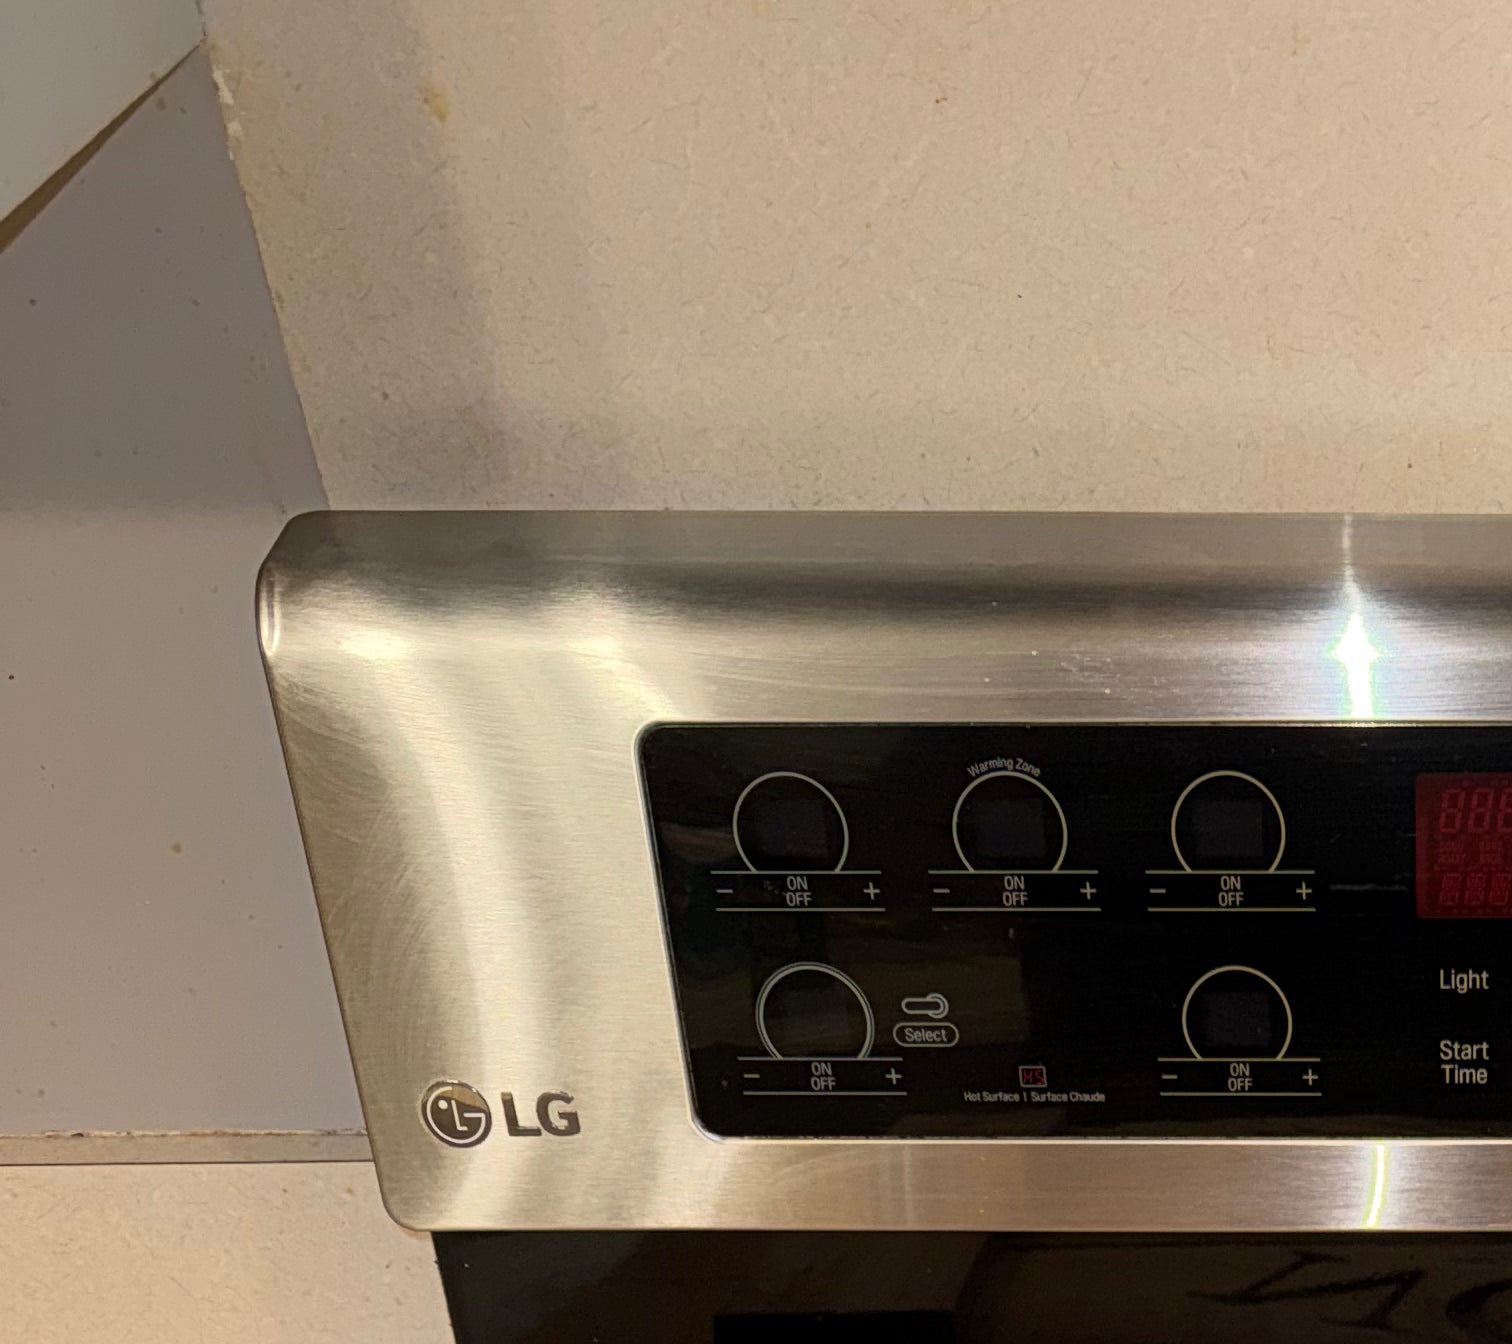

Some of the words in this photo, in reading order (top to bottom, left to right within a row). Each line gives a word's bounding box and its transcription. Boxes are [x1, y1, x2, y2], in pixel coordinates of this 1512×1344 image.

[966, 757, 1015, 777] Warming
[1015, 757, 1041, 777] Zone
[786, 875, 808, 890] ON
[1004, 875, 1025, 891] ON
[1220, 876, 1241, 891] ON
[785, 891, 812, 906] OFF
[1003, 892, 1028, 907] OFF
[1218, 892, 1244, 907] OFF
[1440, 968, 1490, 994] Light
[904, 1027, 948, 1043] Select
[1440, 1040, 1490, 1060] Start
[811, 1062, 832, 1076] ON
[1230, 1063, 1250, 1077] ON
[1441, 1064, 1488, 1084] Time
[811, 1077, 836, 1091] OFF
[1228, 1078, 1253, 1092] OFF
[964, 1091, 981, 1102] Hot
[982, 1091, 1020, 1102] Surface
[1031, 1091, 1068, 1102] Surface
[500, 1091, 581, 1137] LG
